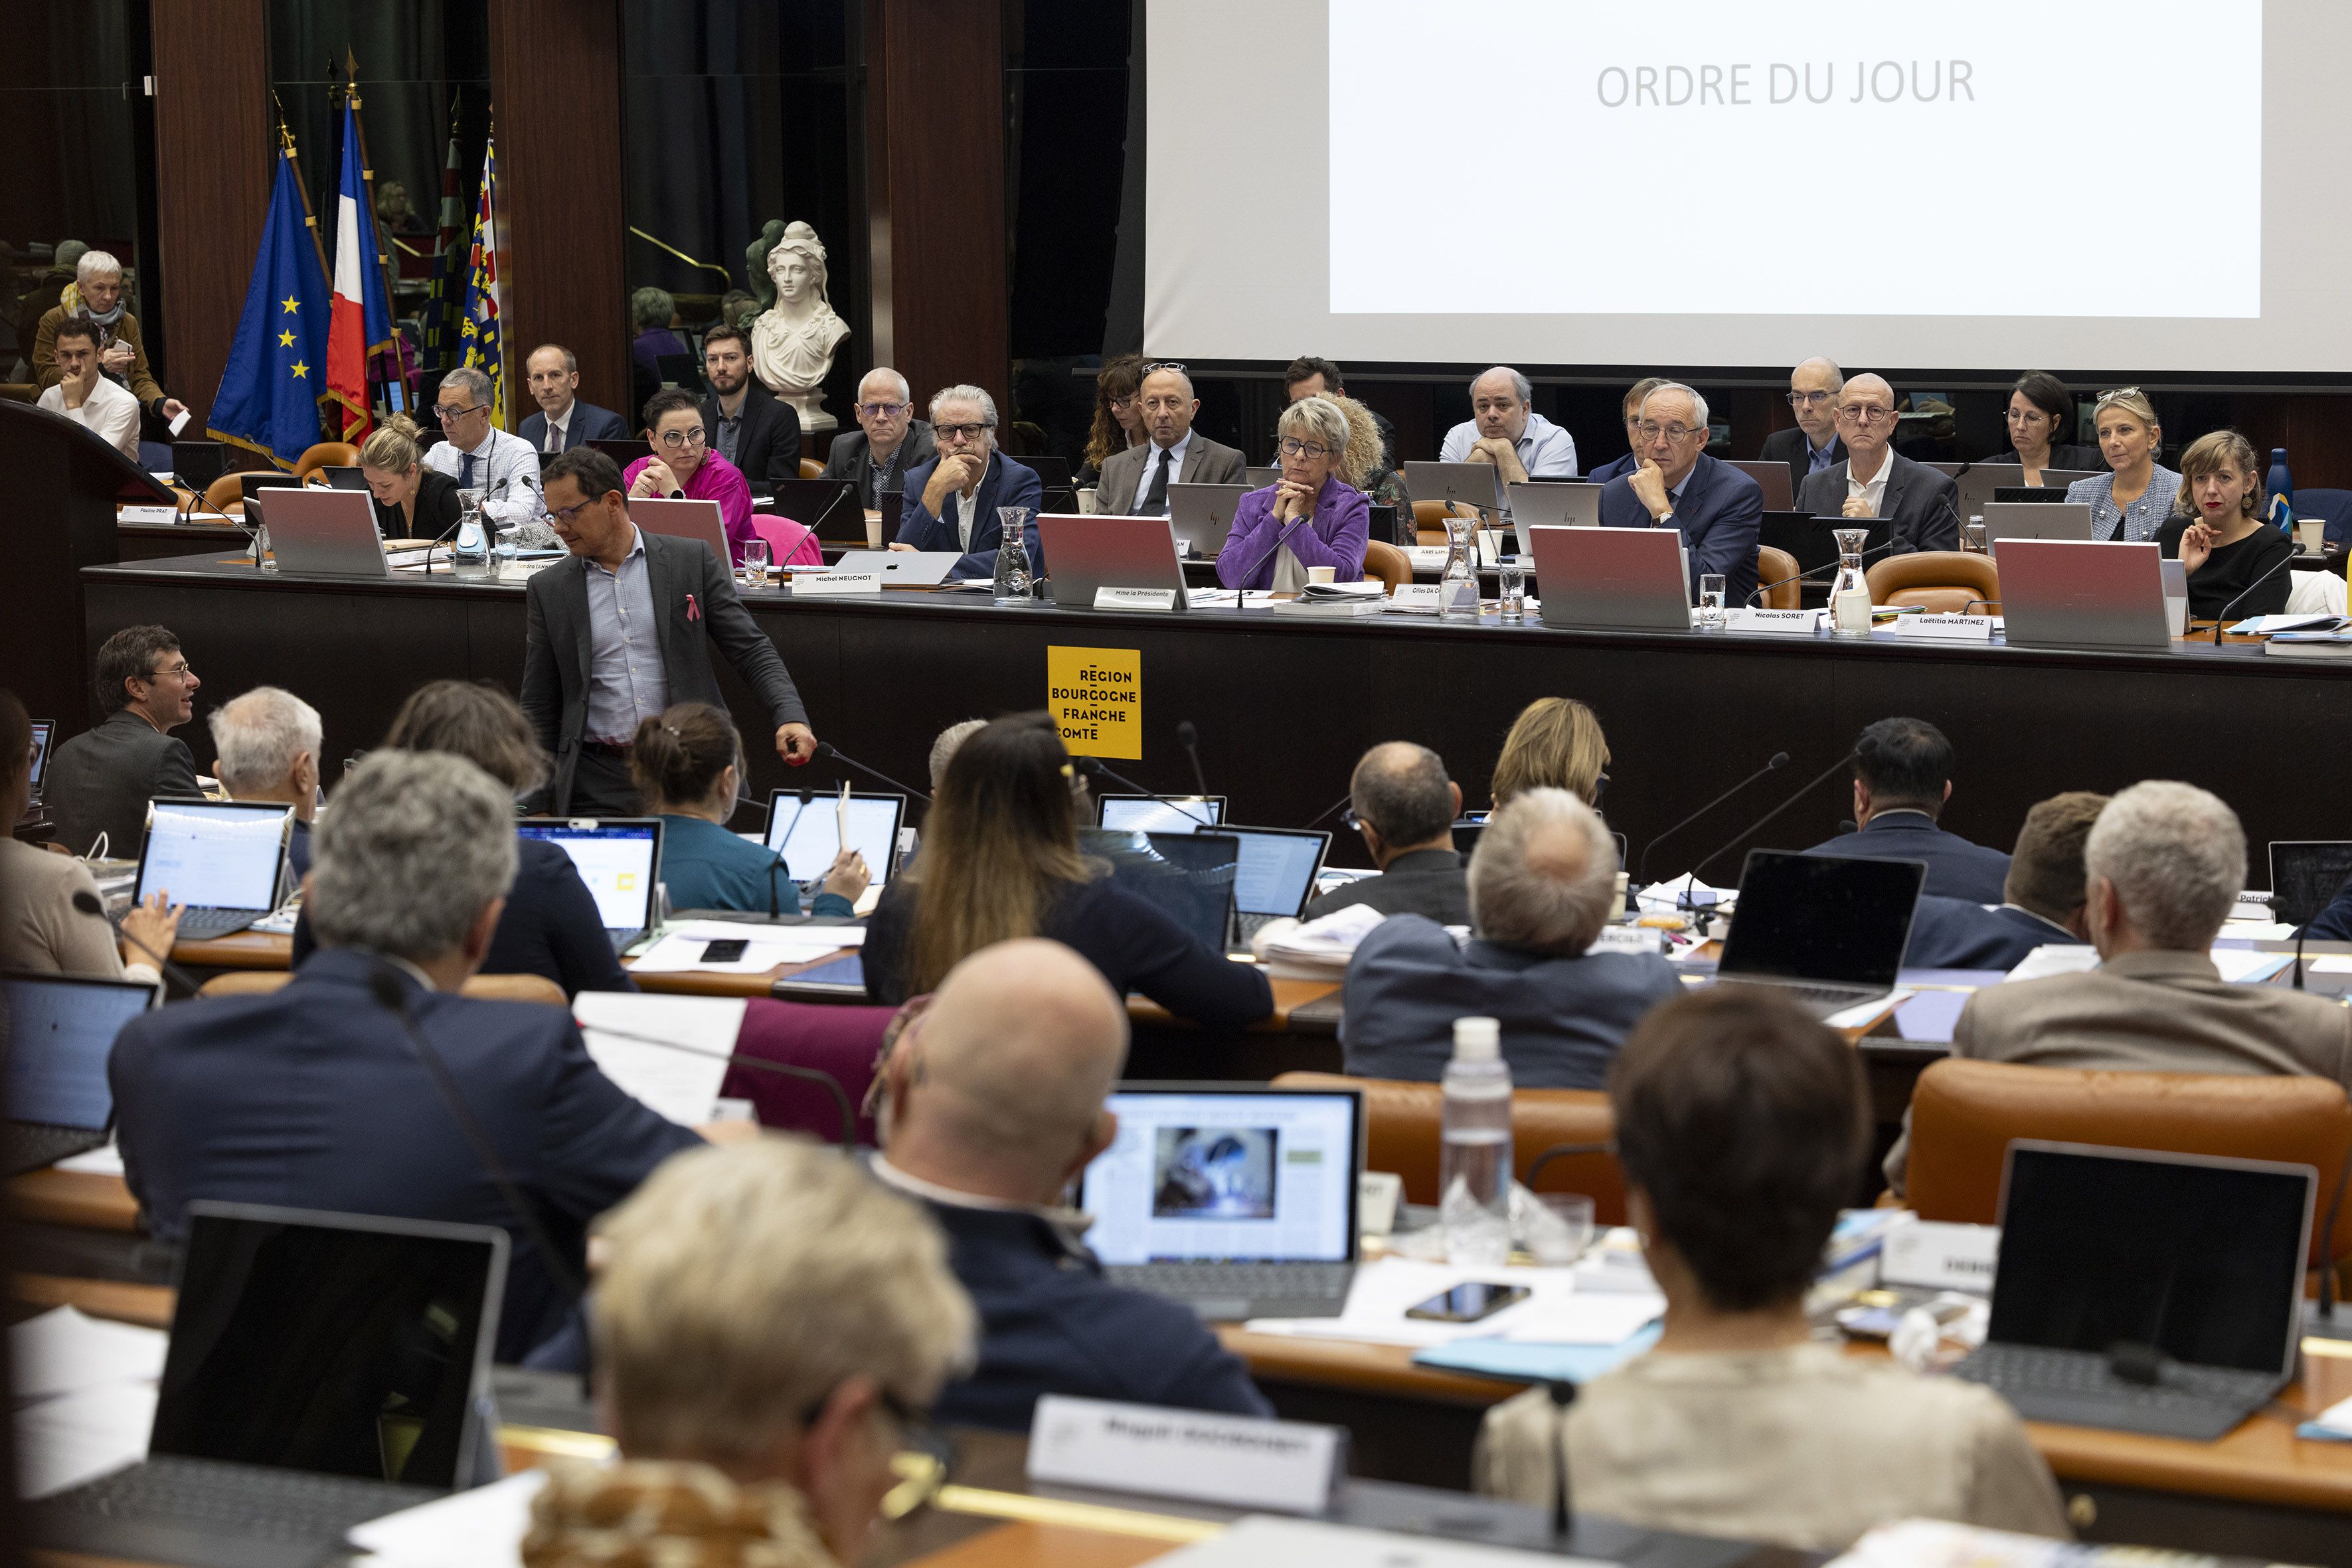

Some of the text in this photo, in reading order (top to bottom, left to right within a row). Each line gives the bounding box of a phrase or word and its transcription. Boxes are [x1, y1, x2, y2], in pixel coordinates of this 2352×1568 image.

[1597, 59, 1975, 108] ORDRE DU JOUR
[1052, 688, 1136, 703] BOURGOGNE
[1063, 708, 1126, 722] FRANCHE
